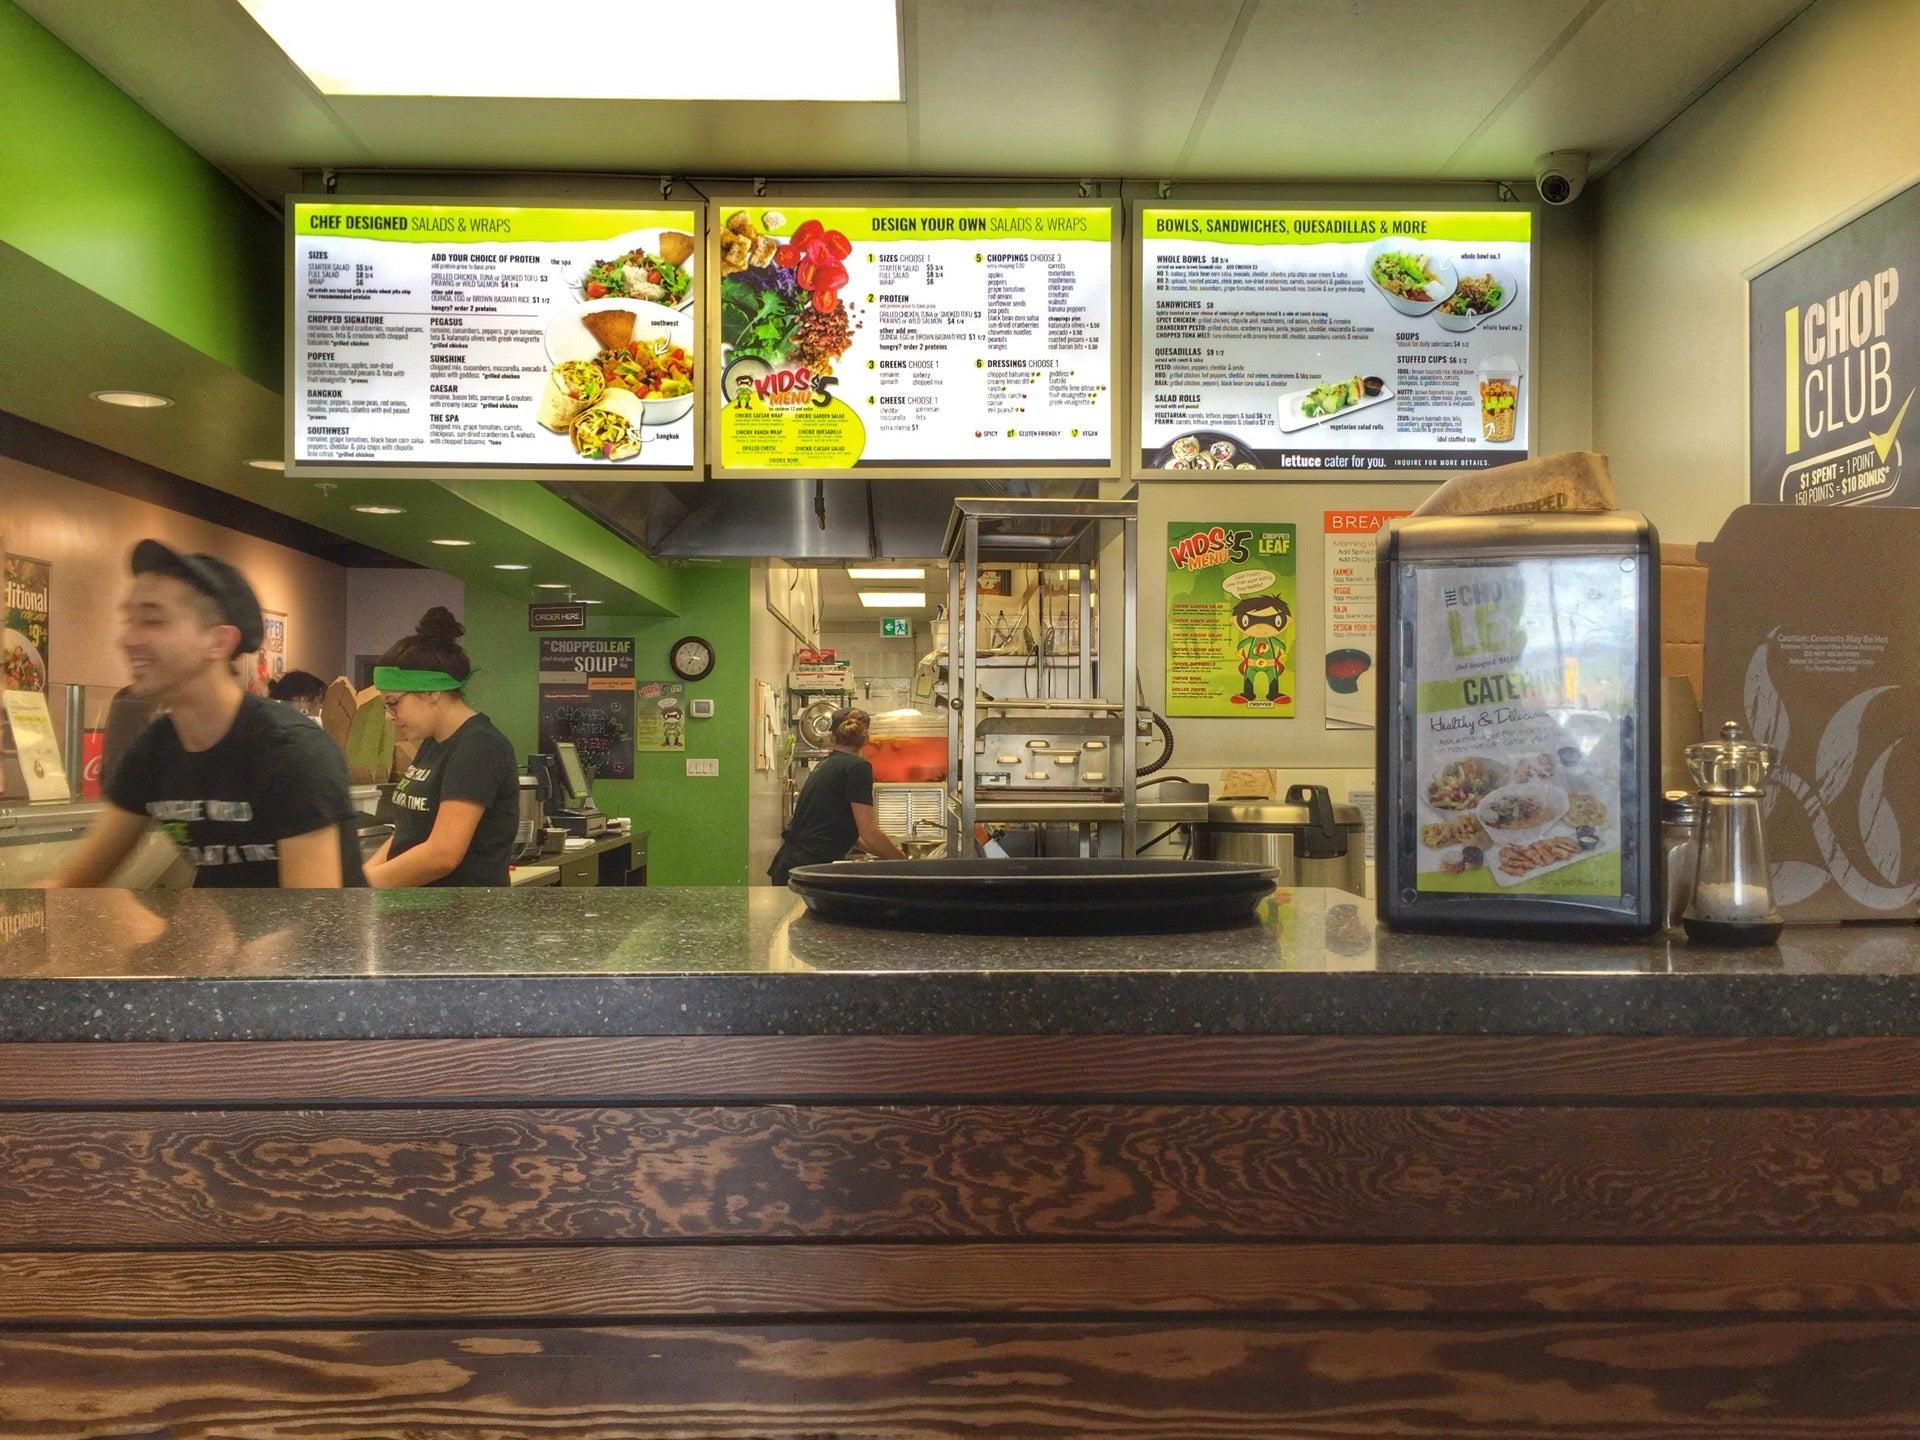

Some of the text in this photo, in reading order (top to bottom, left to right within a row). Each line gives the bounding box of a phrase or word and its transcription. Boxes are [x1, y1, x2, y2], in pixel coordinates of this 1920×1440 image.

[310, 215, 511, 233] CHEF DESIGNED SALADS & WRAPS
[872, 217, 1087, 231] DESIGN YOUR OWN SALADS & WRAPS
[1156, 219, 1427, 234] BOWLS, SANDWICHES, QUESADILLAS & MORE
[308, 251, 328, 259] SIZES
[499, 255, 506, 263] OF
[510, 255, 540, 263] PROTEIN
[879, 254, 898, 262] SIZES
[987, 254, 1028, 262] CHOPPINGS
[1030, 254, 1055, 262] CHOOSE
[1157, 255, 1180, 263] WHOLE
[1156, 301, 1201, 309] SANDWICHES
[308, 315, 383, 324] CHOPPED SIGNATURE
[1804, 266, 1899, 366] CHOP
[430, 318, 463, 326] PEGASUS
[307, 352, 335, 360] POPEYE
[1155, 348, 1201, 356] QUESADILLAS
[430, 355, 466, 363] SUNSHINE
[1397, 355, 1426, 363] STUFFED
[755, 367, 811, 401] KIDS
[307, 390, 342, 398] BANGKOK
[1805, 341, 1892, 439] CLUB
[770, 391, 813, 406] MENU
[1155, 394, 1201, 402] SALAD ROLLS
[430, 414, 459, 422] THE SPA
[307, 427, 350, 435] SOUTHWEST
[1281, 454, 1387, 469] lettuce cater for you.
[1800, 472, 1809, 490] $1
[1812, 463, 1837, 486] SPENT
[1847, 460, 1850, 474] 1
[1852, 451, 1875, 473] POINT
[1795, 491, 1807, 506] 150
[1809, 483, 1834, 504] POINTS
[1841, 475, 1856, 495] $10
[1169, 527, 1225, 569] KIDS
[1259, 540, 1290, 554] LEAF
[1188, 548, 1230, 572] MENU
[1444, 588, 1457, 608] THE
[574, 656, 618, 673] SOUP
[1430, 717, 1475, 734] Healthy
